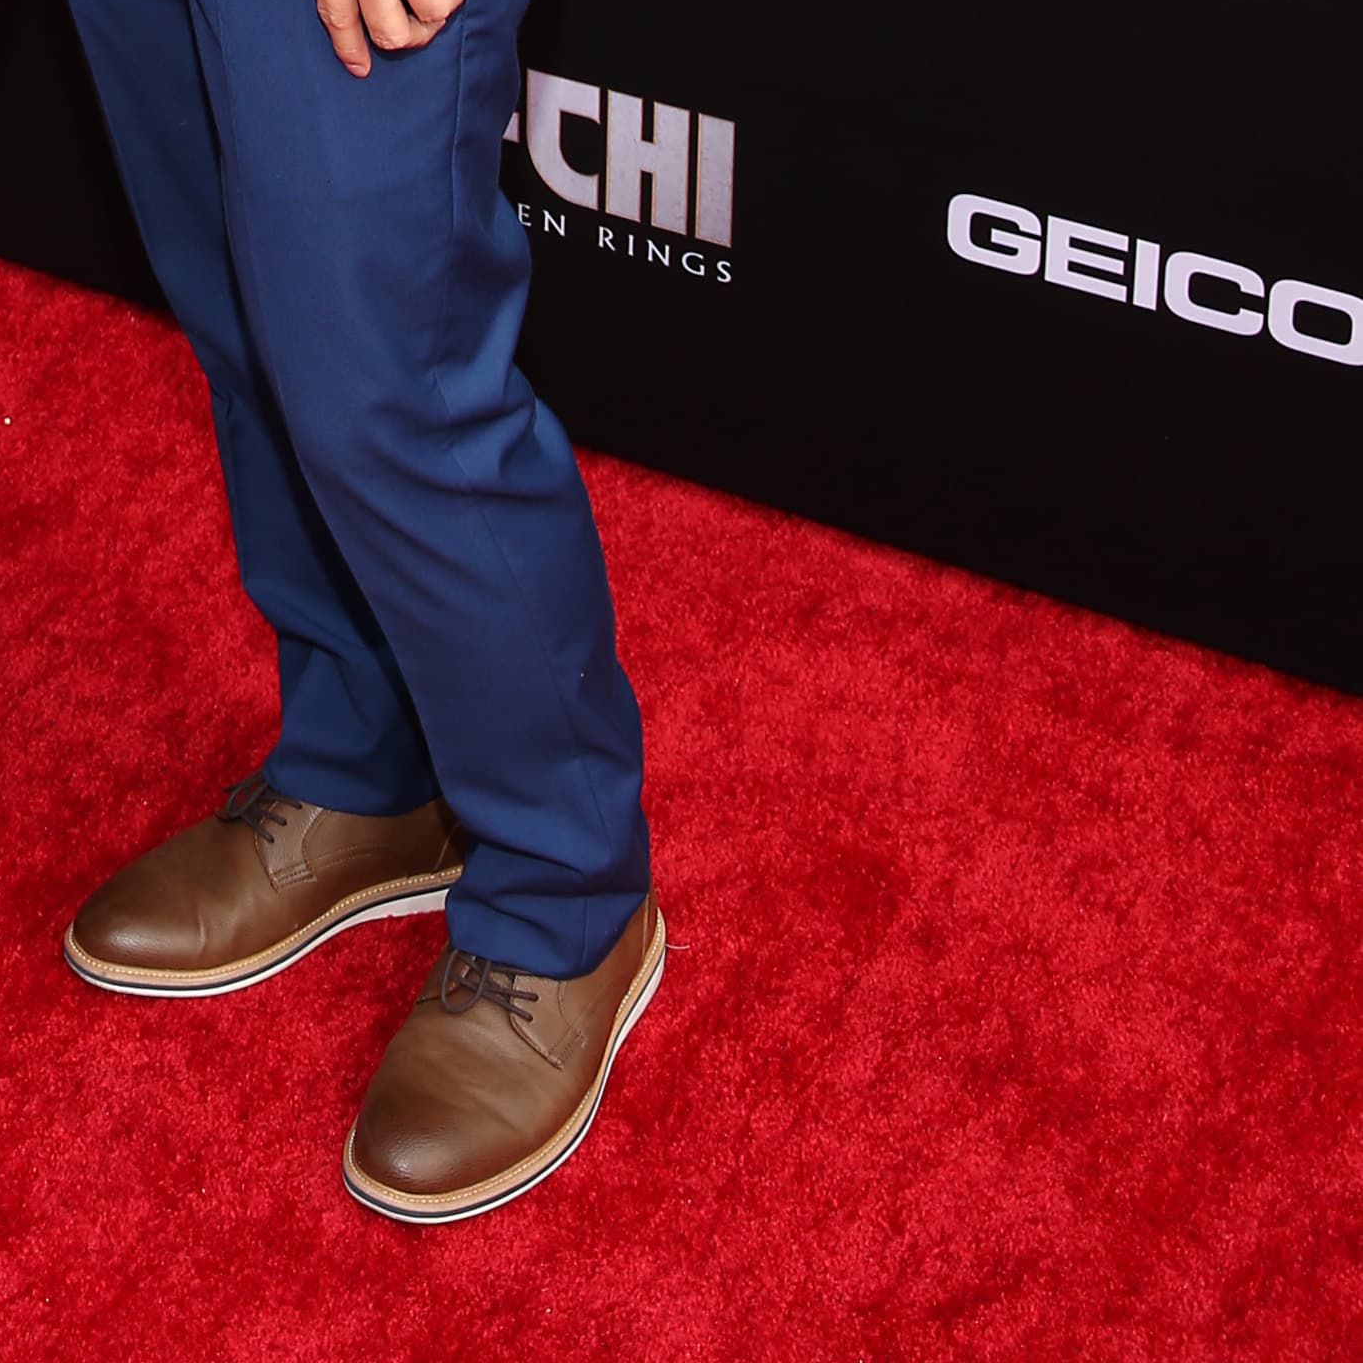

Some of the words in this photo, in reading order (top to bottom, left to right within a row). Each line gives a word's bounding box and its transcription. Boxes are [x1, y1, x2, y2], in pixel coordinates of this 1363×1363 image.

[517, 203, 566, 237] EN
[599, 226, 732, 283] RINGS
[947, 194, 1363, 365] GEICO
